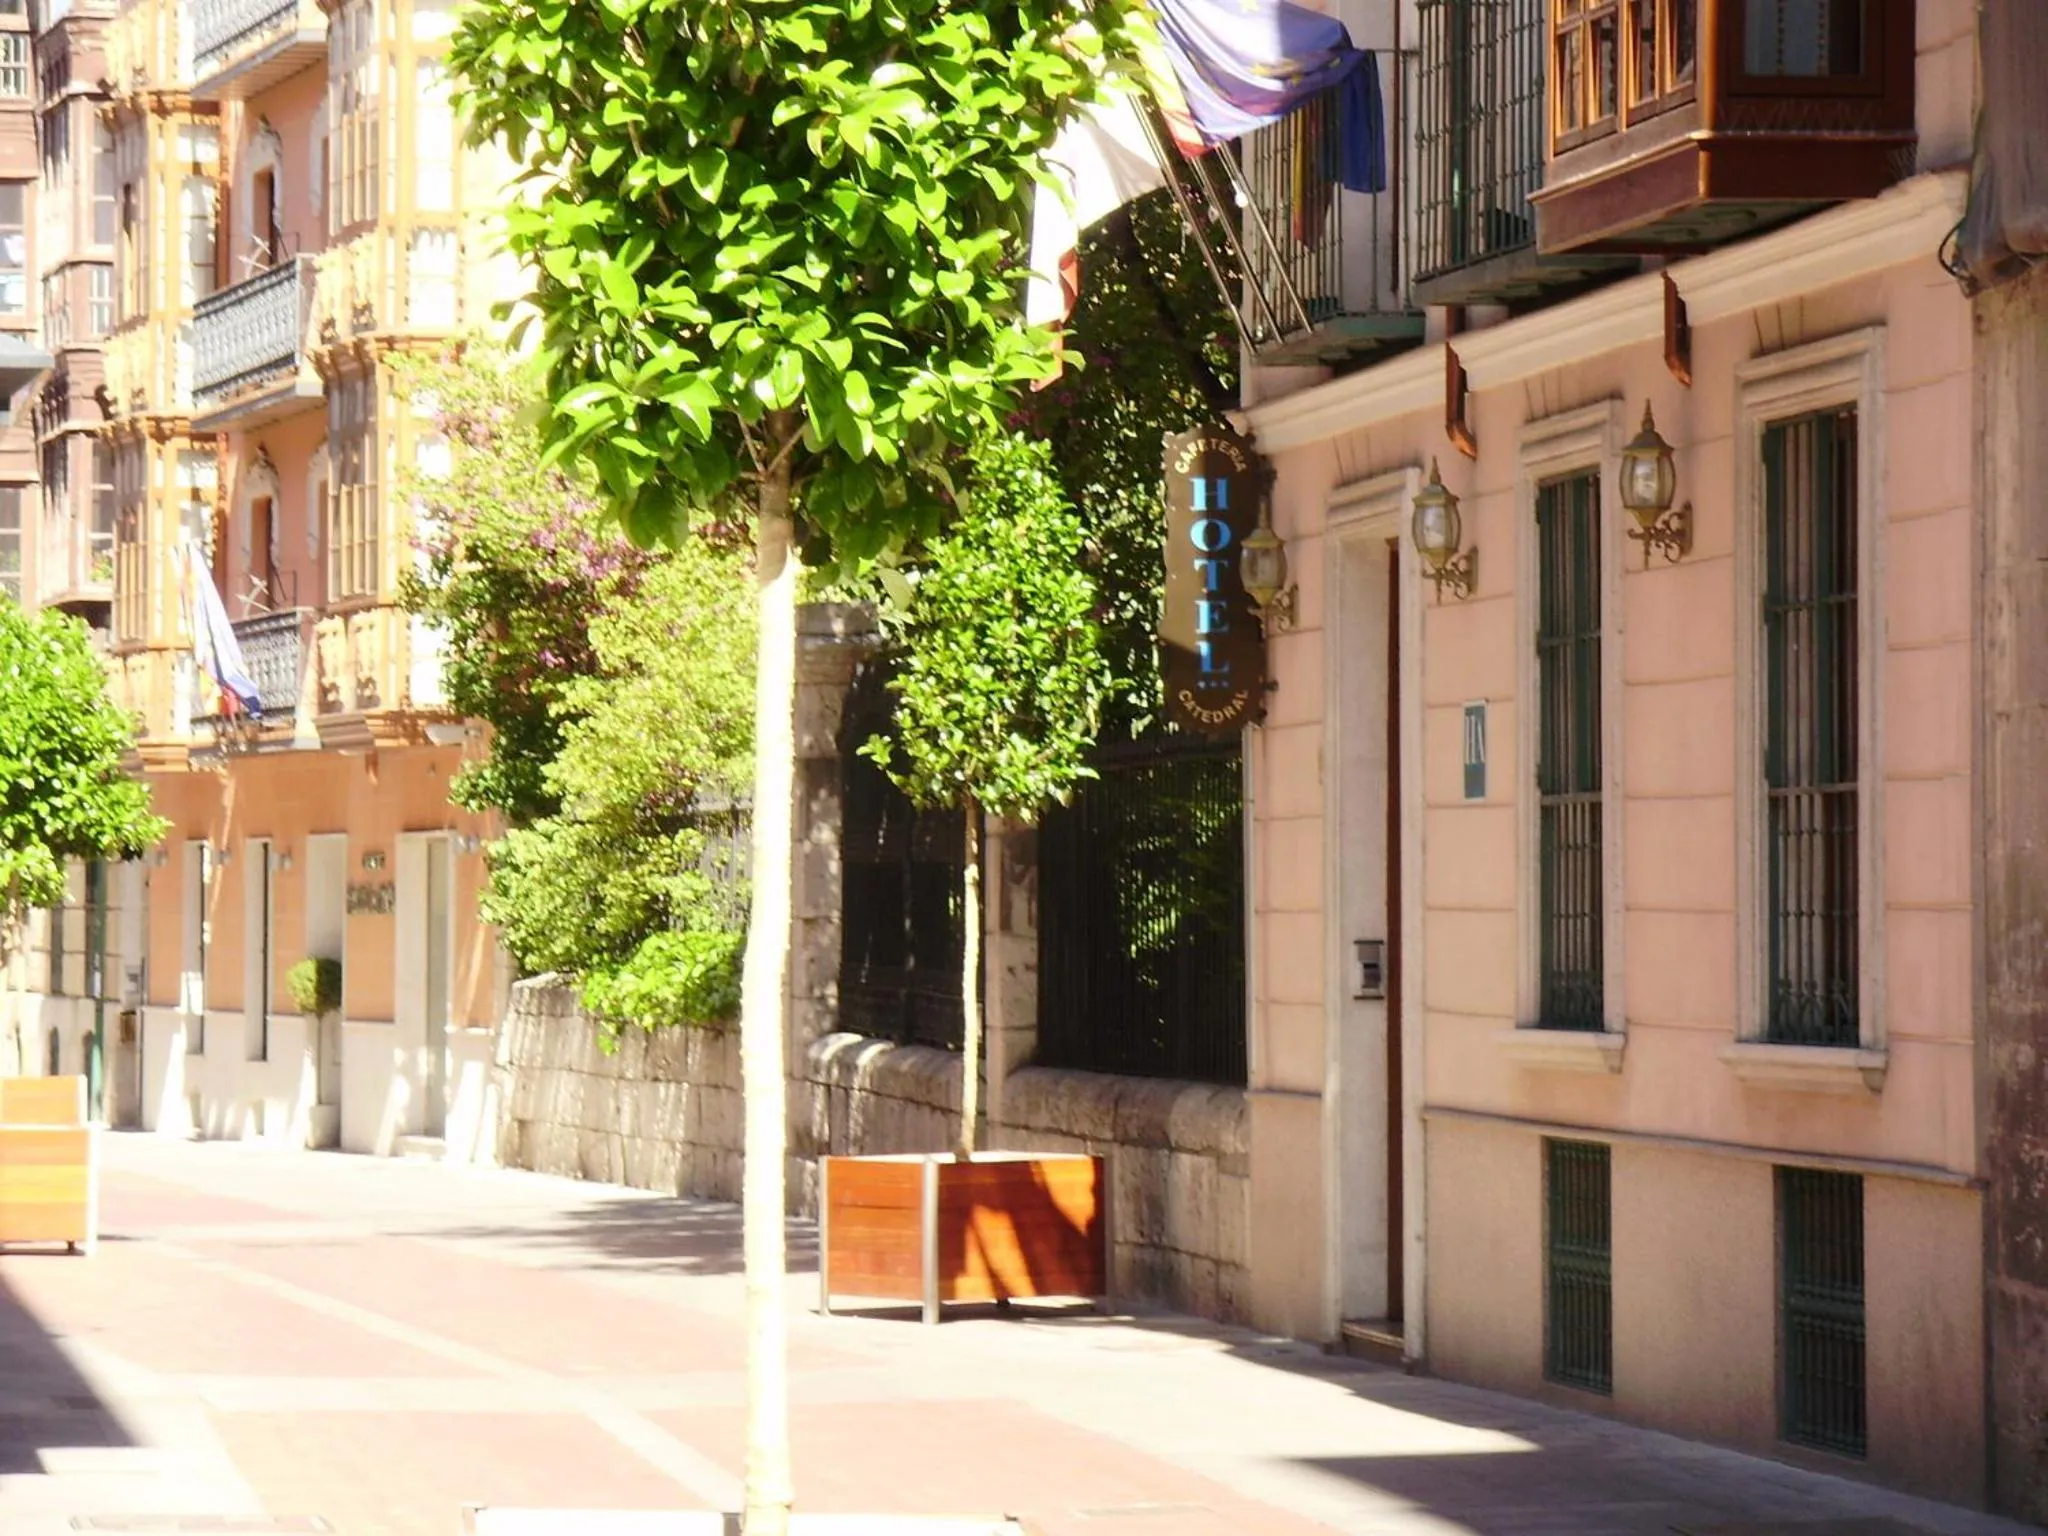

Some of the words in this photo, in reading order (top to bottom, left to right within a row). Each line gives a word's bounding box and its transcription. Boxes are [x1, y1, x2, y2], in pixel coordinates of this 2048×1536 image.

[1174, 438, 1247, 474] CAFETERIA
[1188, 475, 1231, 673] HOTEL
[1179, 689, 1249, 723] CATEDRAL
